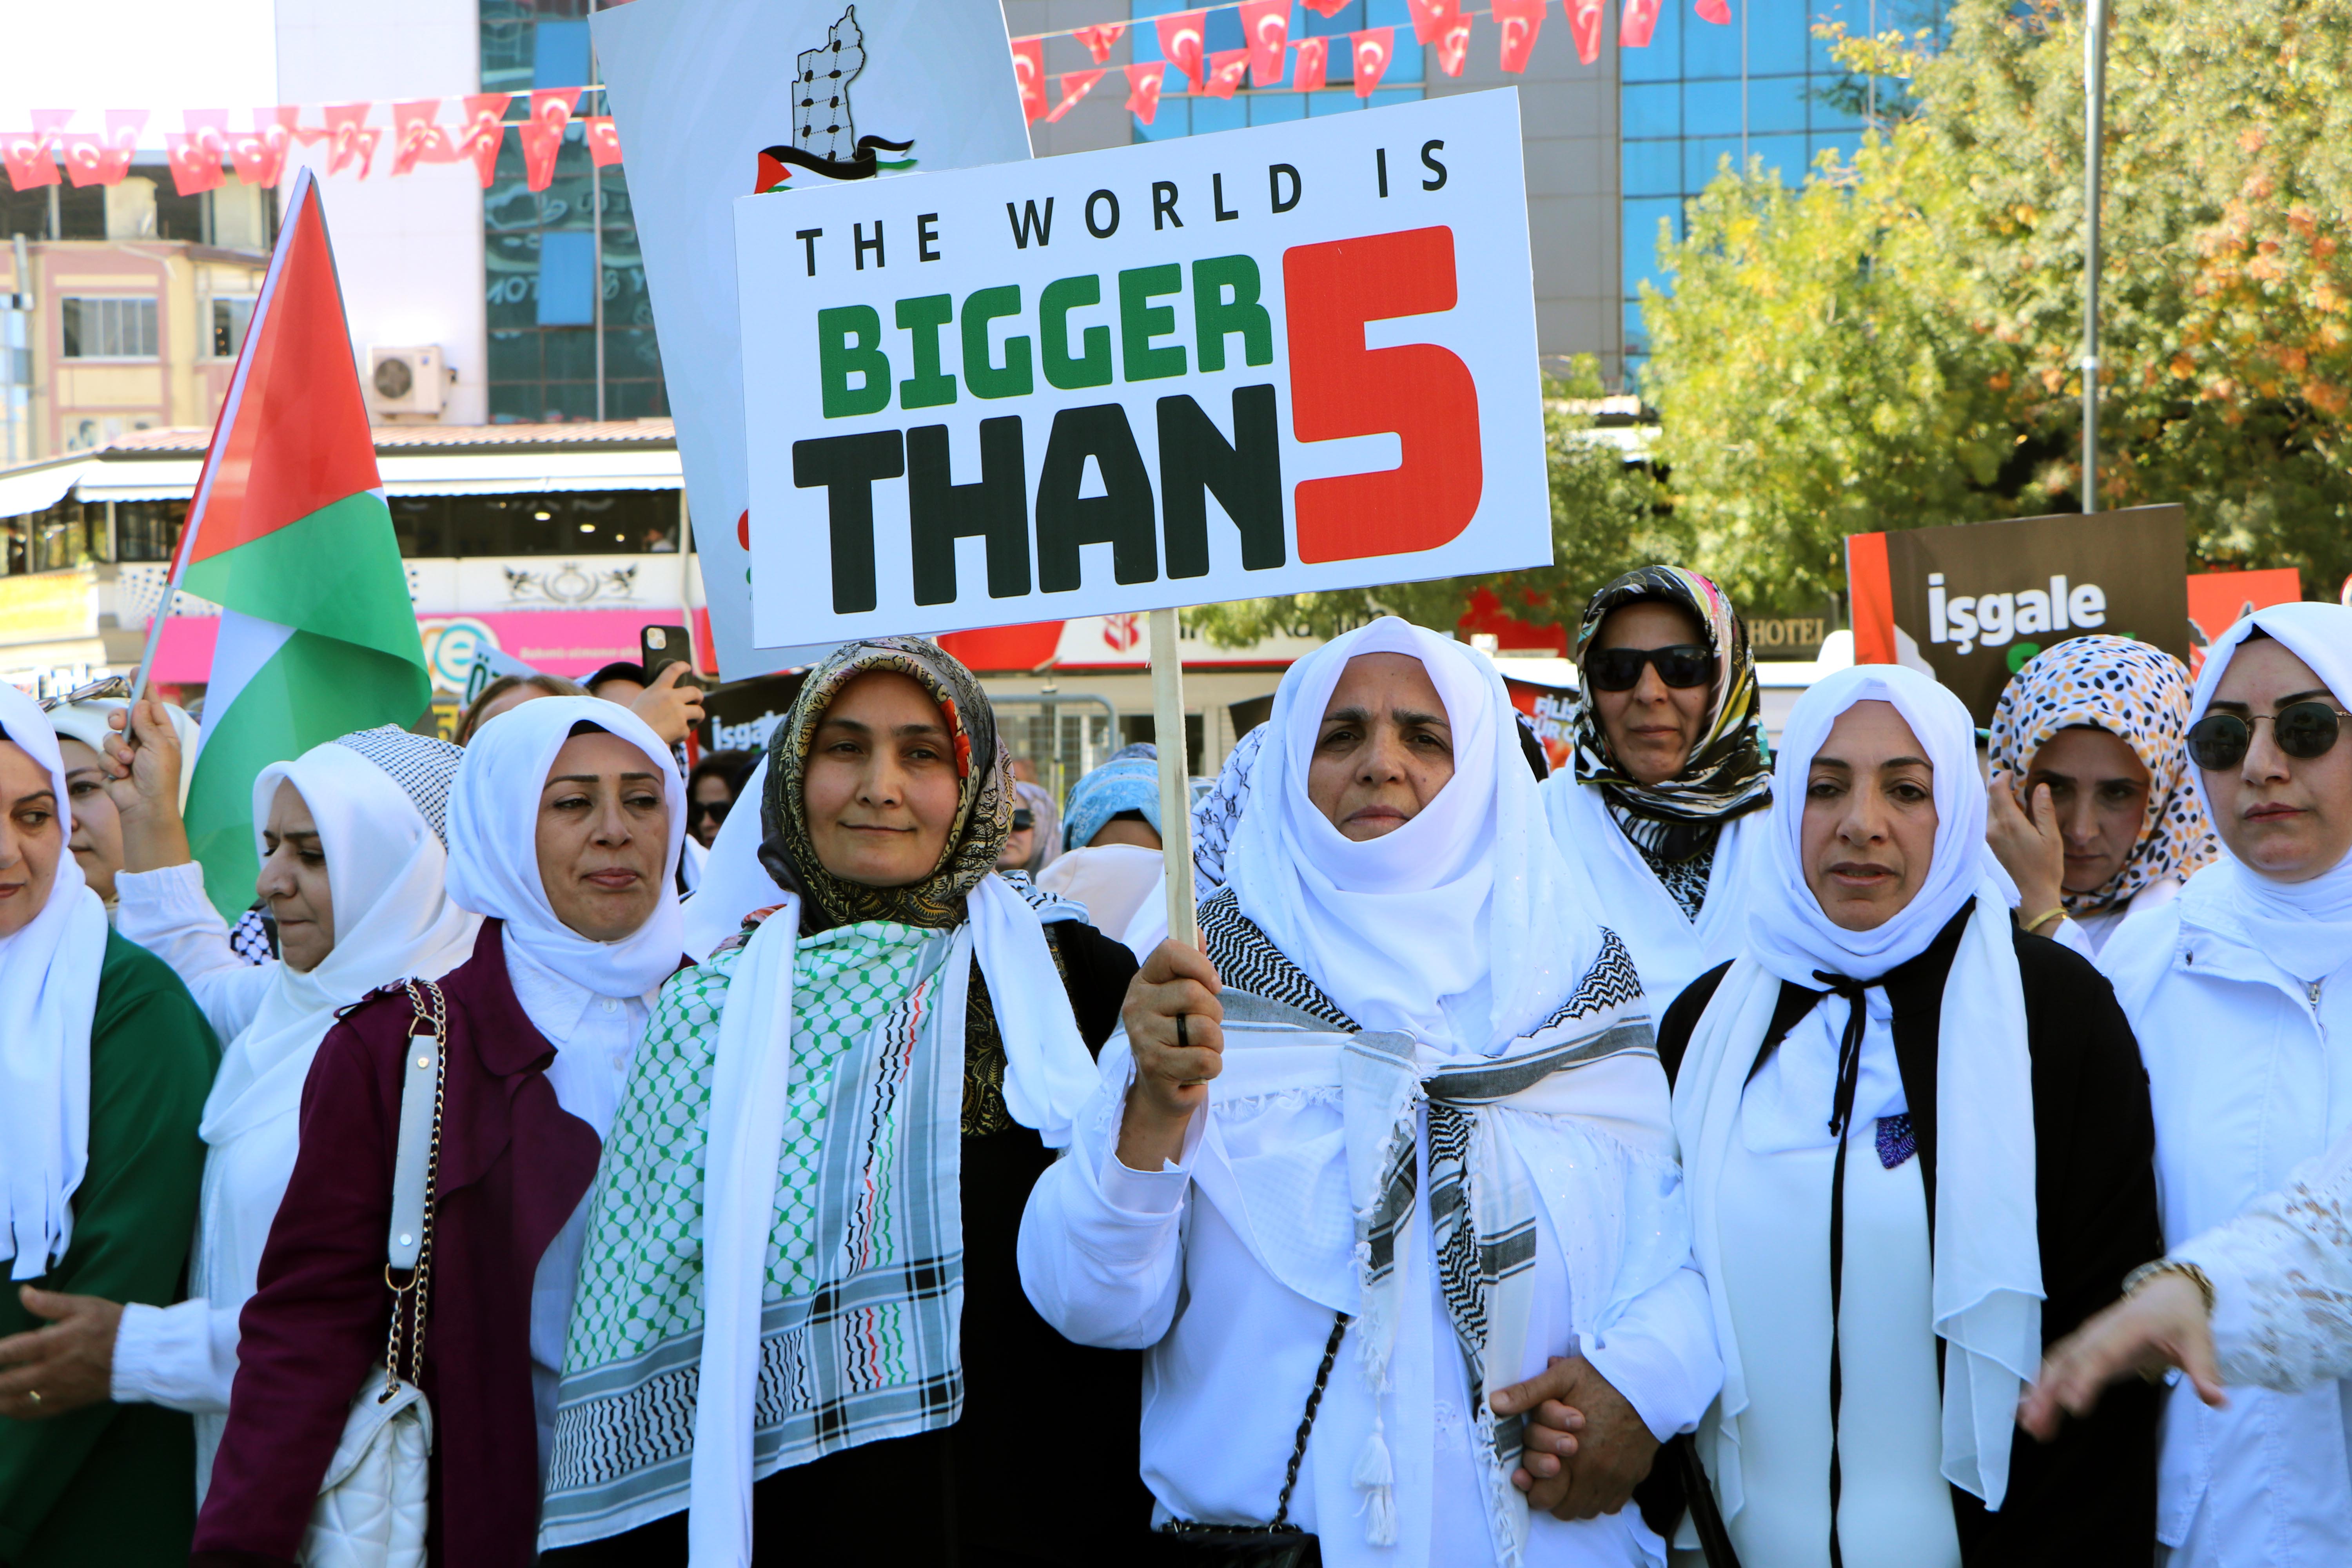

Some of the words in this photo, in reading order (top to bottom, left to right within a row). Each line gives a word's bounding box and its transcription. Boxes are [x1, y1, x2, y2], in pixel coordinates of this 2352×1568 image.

[797, 212, 941, 276] THE
[1006, 163, 1301, 249] WORLD
[1376, 140, 1447, 198] IS
[818, 255, 1273, 419] BIGGER
[792, 384, 1286, 614] THAN
[1283, 225, 1483, 564] 5
[1748, 618, 1825, 645] HOTEL
[1928, 572, 2107, 655] İşgale
